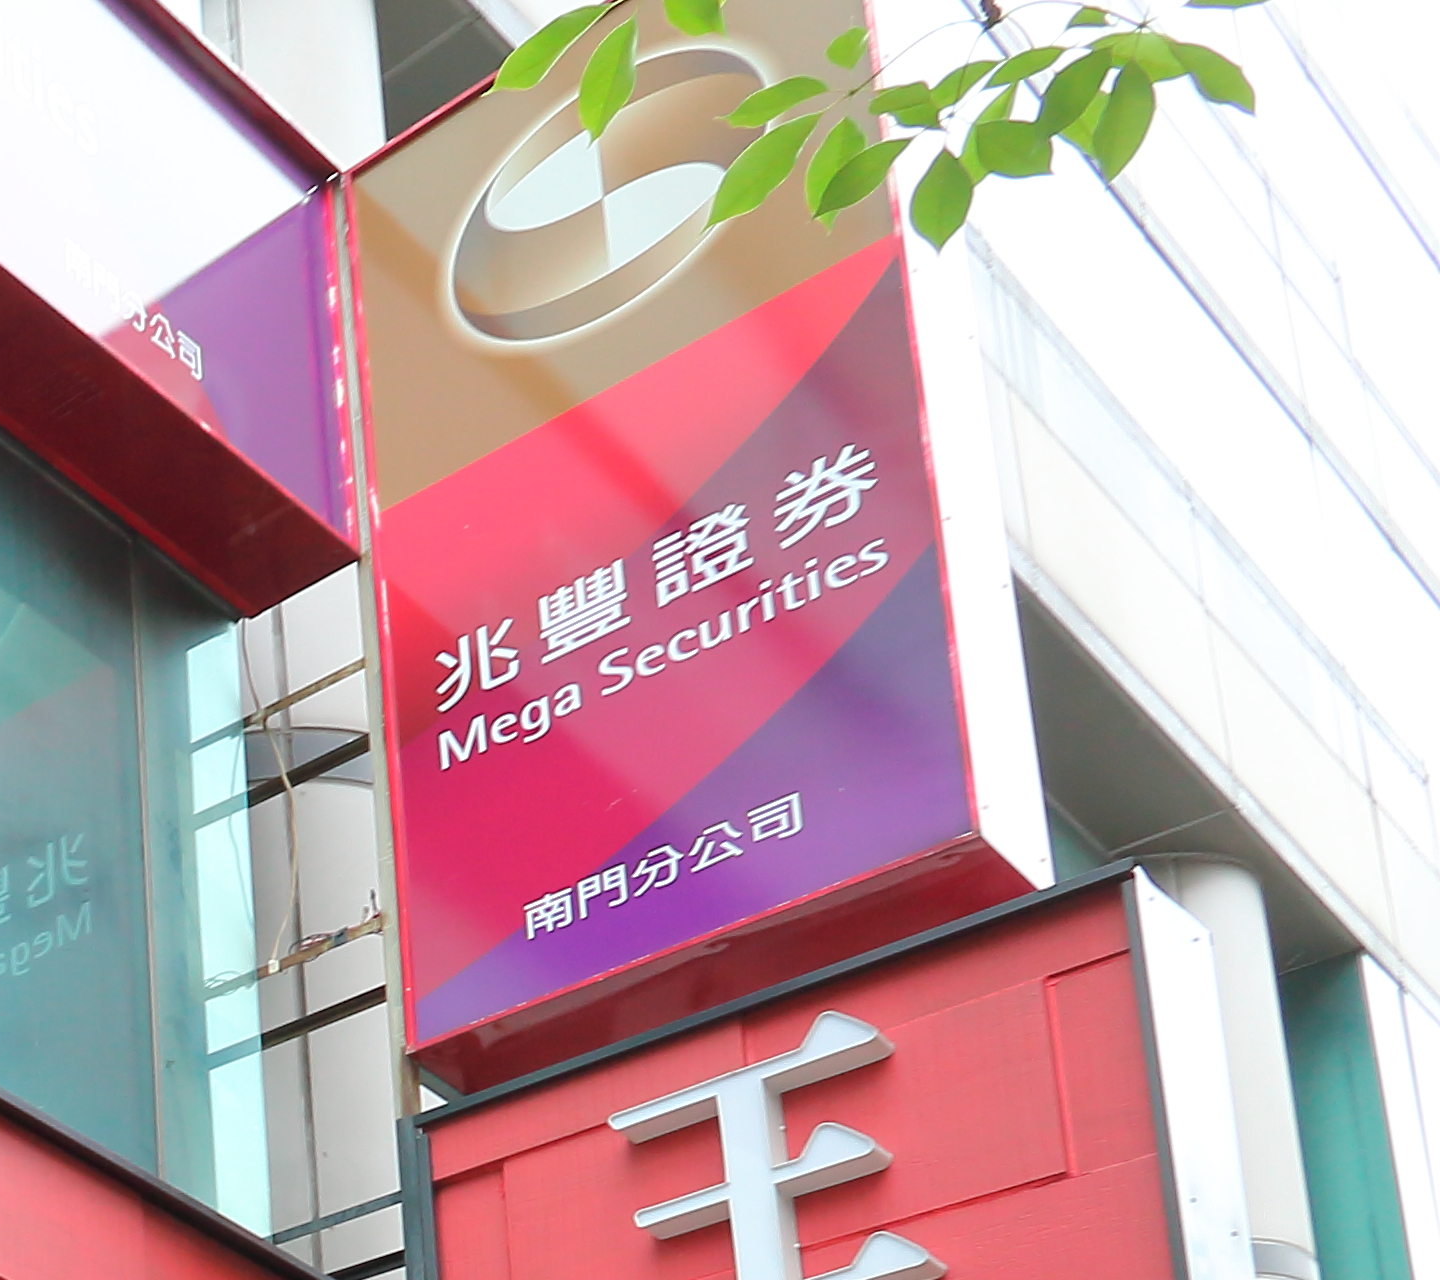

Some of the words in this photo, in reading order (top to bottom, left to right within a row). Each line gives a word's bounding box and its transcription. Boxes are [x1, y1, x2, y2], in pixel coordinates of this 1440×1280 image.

[434, 444, 878, 712] 兆豐證券
[437, 682, 582, 771] Mega
[598, 538, 890, 697] Securities
[523, 791, 805, 940] 南門分公司
